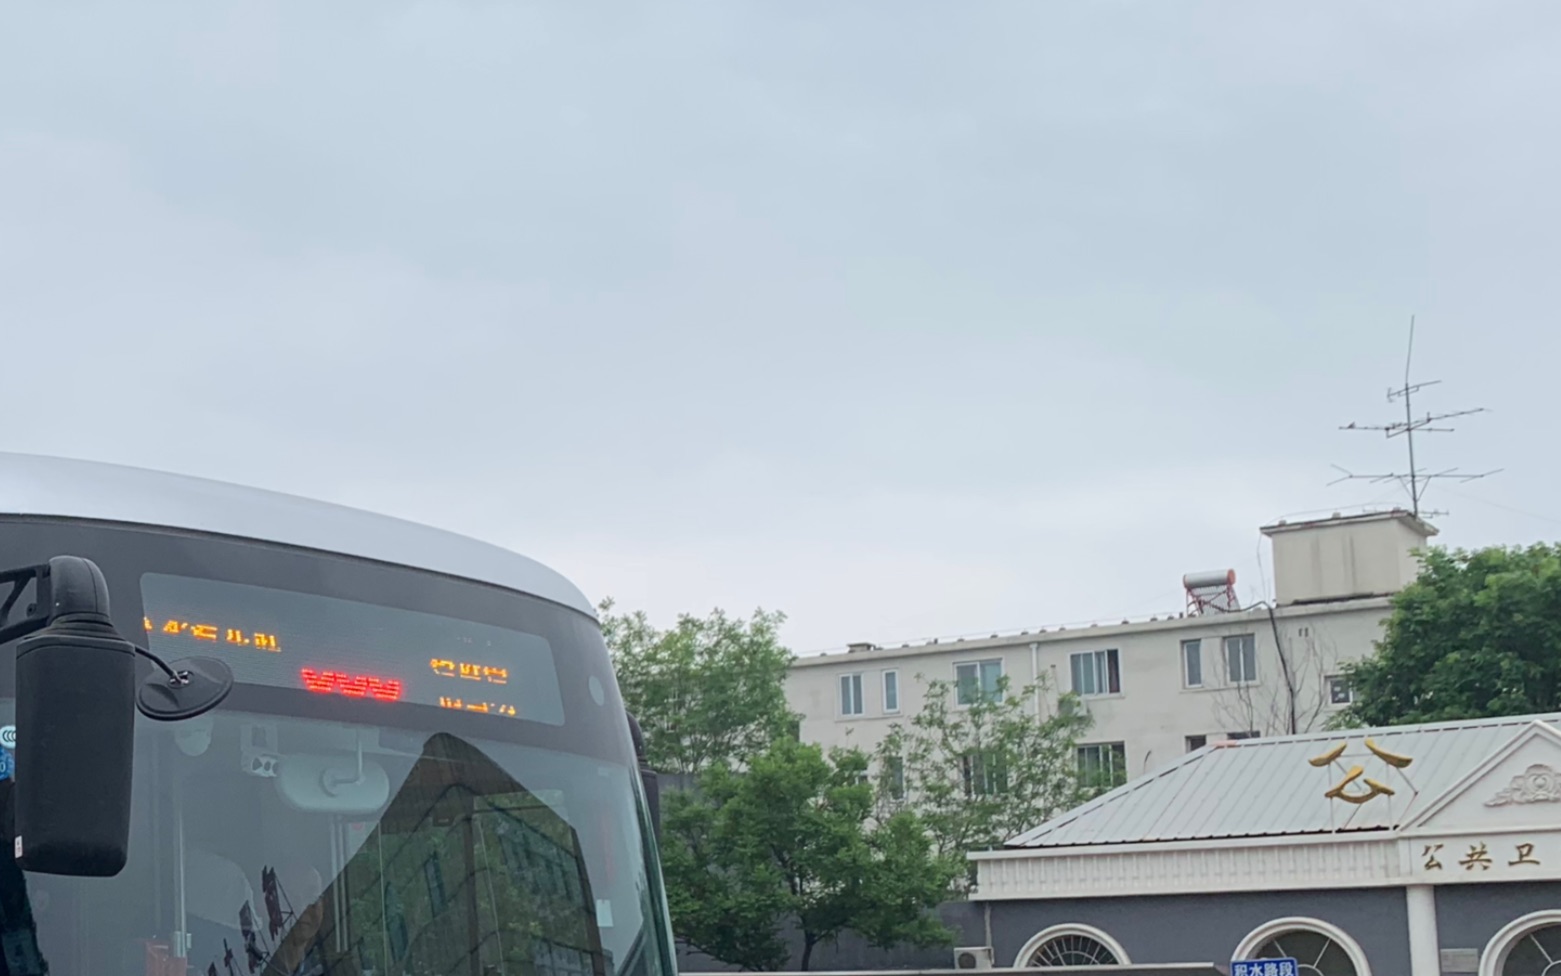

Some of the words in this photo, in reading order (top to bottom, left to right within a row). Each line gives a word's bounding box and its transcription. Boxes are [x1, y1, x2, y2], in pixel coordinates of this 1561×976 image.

[1308, 738, 1413, 804] 公
[1421, 840, 1541, 872] 公共卫
